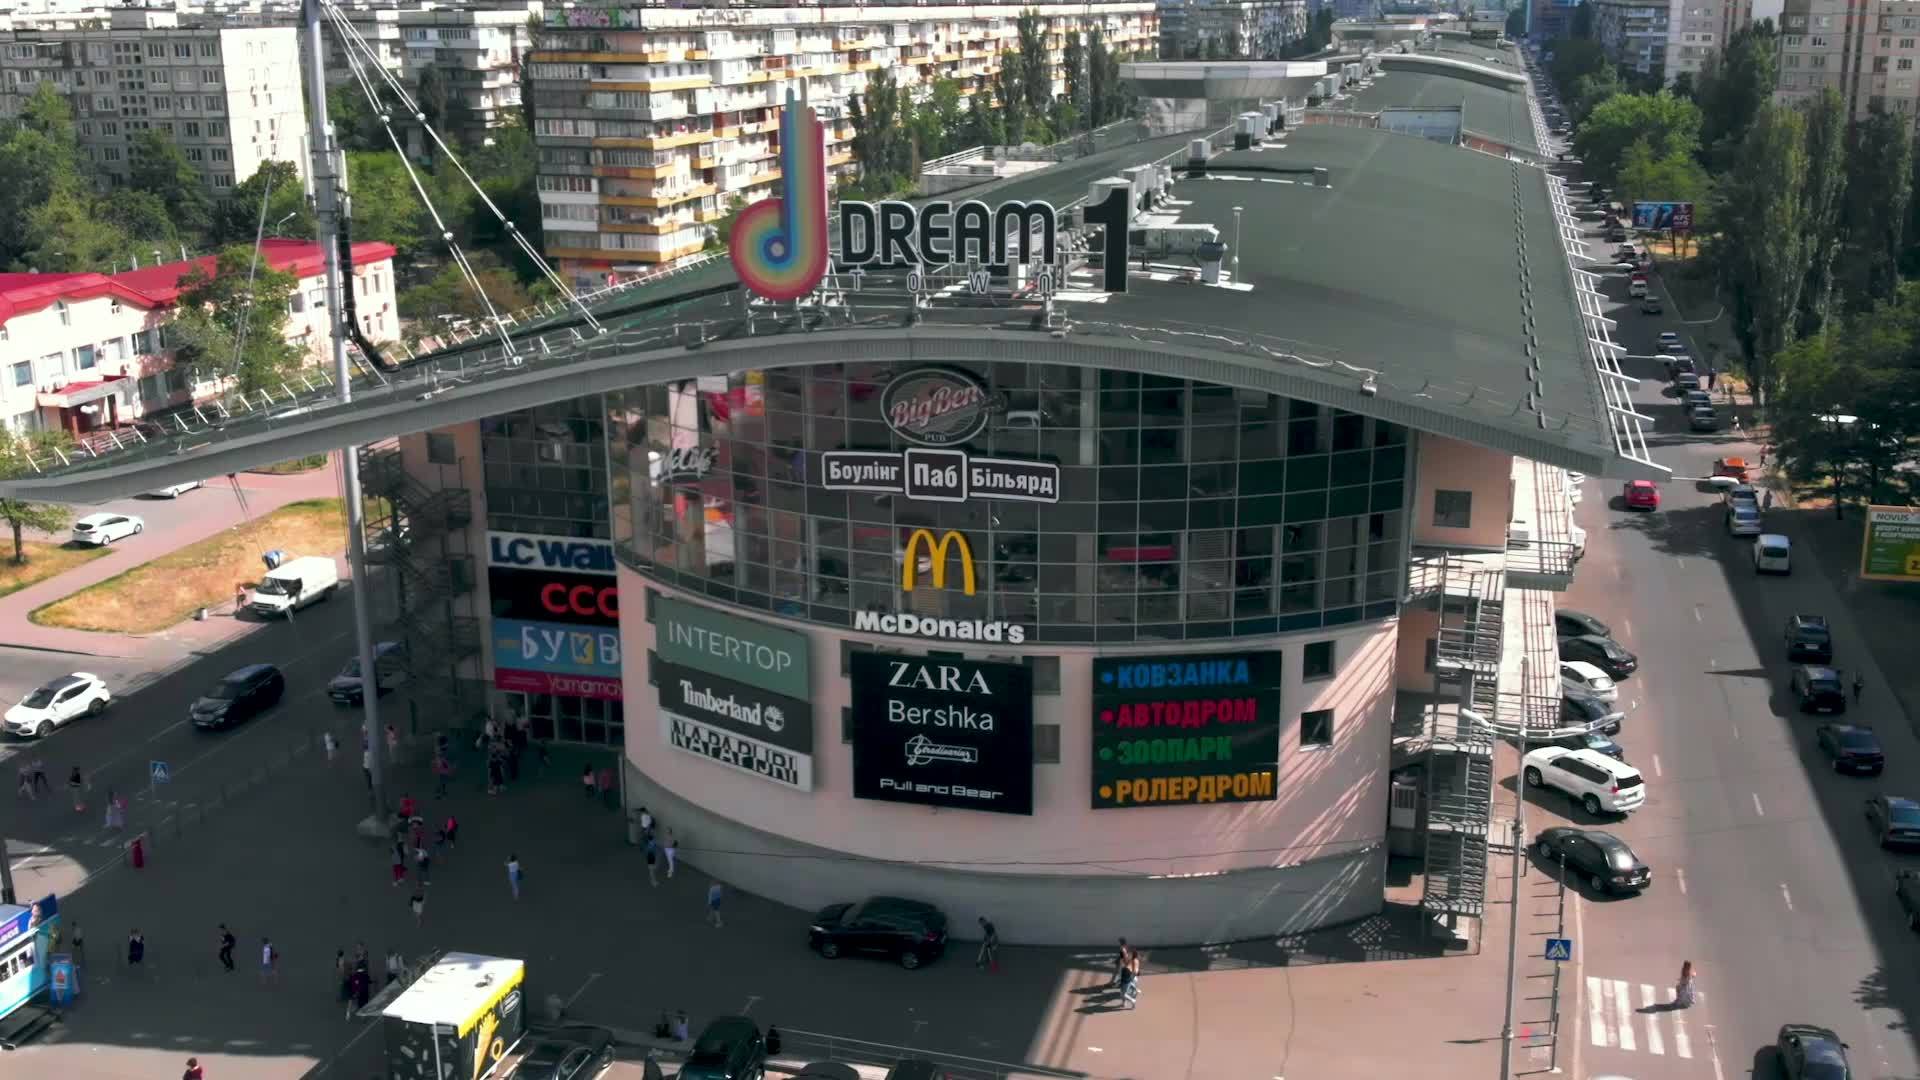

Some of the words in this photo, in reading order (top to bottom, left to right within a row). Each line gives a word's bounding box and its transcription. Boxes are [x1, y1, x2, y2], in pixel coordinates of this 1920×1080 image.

[839, 200, 1057, 266] DREAM
[1083, 186, 1130, 293] 1
[829, 460, 900, 484] Боулінг
[913, 463, 958, 488] Паб
[971, 467, 1054, 495] Більярд
[1876, 512, 1910, 521] NOVUS
[490, 535, 535, 565] LC
[855, 610, 1025, 644] McDonald's
[668, 620, 792, 673] INTERTOP
[888, 660, 993, 695] ZARA
[1117, 659, 1249, 689] КОВЗАНКА
[680, 679, 762, 727] Timberland
[889, 699, 994, 731] Bershka
[1117, 698, 1257, 729] АВТОДРОМ
[1117, 735, 1233, 765] ЗООПАРК
[880, 778, 912, 791] Pull
[915, 782, 949, 795] and
[952, 784, 1004, 800] Bear
[1115, 771, 1273, 804] РОЛЕРДРОМ
